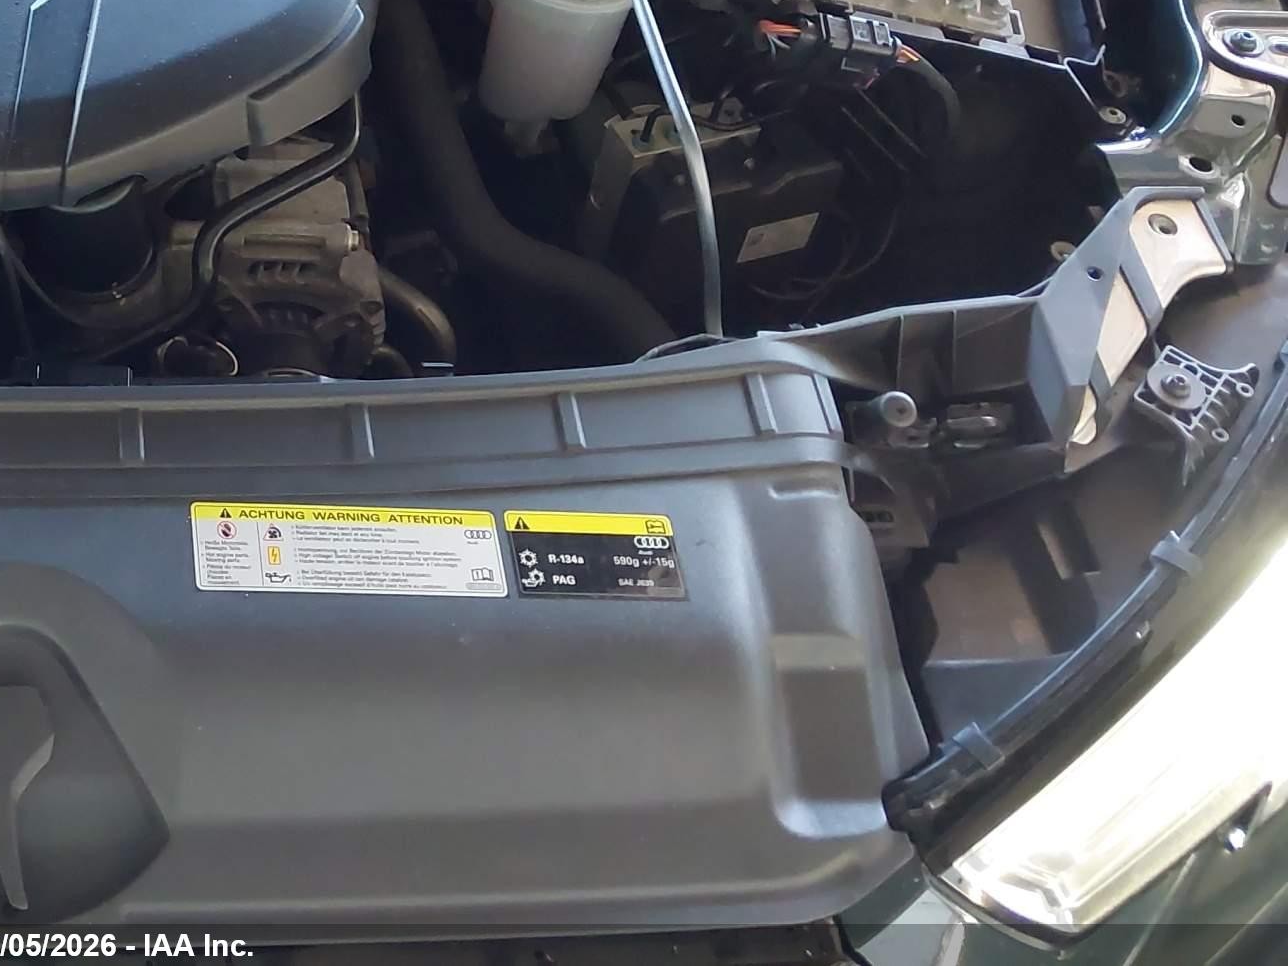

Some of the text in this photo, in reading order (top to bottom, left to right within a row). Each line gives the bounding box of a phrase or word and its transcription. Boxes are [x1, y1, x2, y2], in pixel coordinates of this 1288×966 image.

[238, 509, 463, 525] ACHTUNG WARNING ATTENTION
[547, 553, 585, 565] R-134a
[613, 555, 640, 568] 590g
[552, 575, 576, 585] PAG
